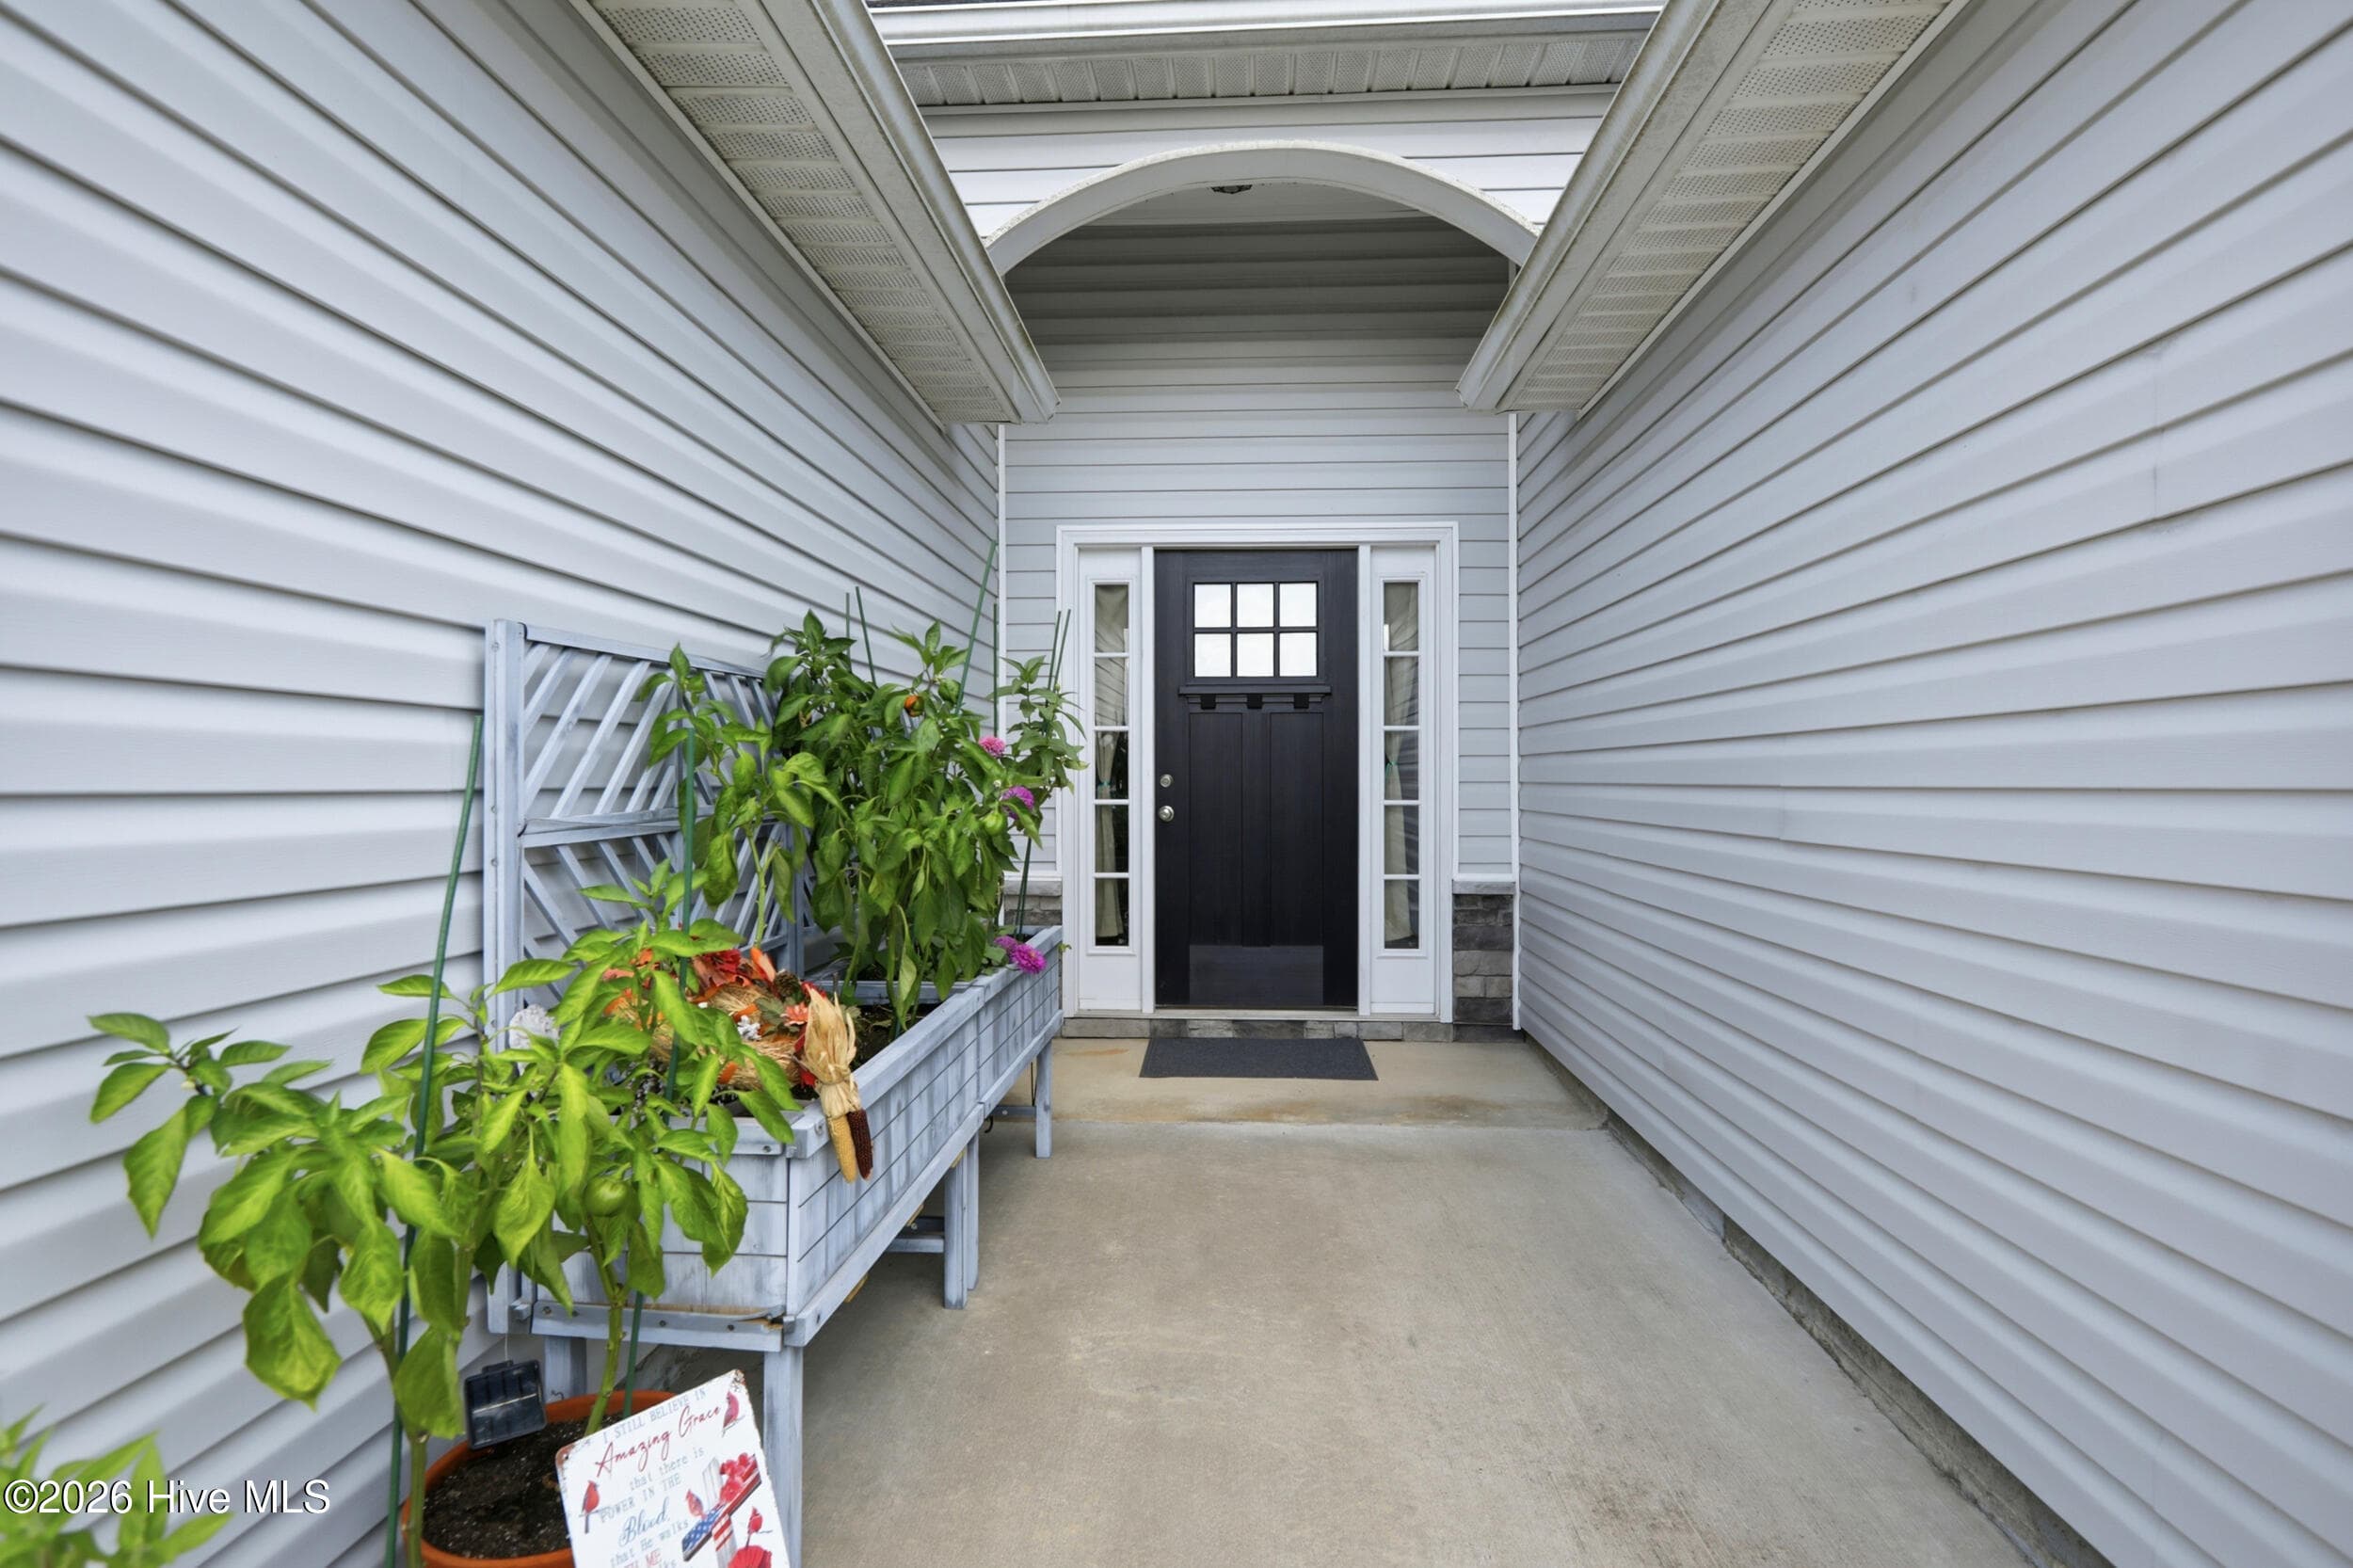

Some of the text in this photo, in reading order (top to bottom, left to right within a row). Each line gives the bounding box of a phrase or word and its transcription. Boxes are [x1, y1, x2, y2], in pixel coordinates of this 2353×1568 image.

[602, 1430, 609, 1444] I
[615, 1418, 646, 1439] STILL
[649, 1394, 690, 1422] BELIEVE
[595, 1404, 721, 1478] Amazing Grace
[630, 1471, 653, 1492] that
[662, 1472, 682, 1492] THE
